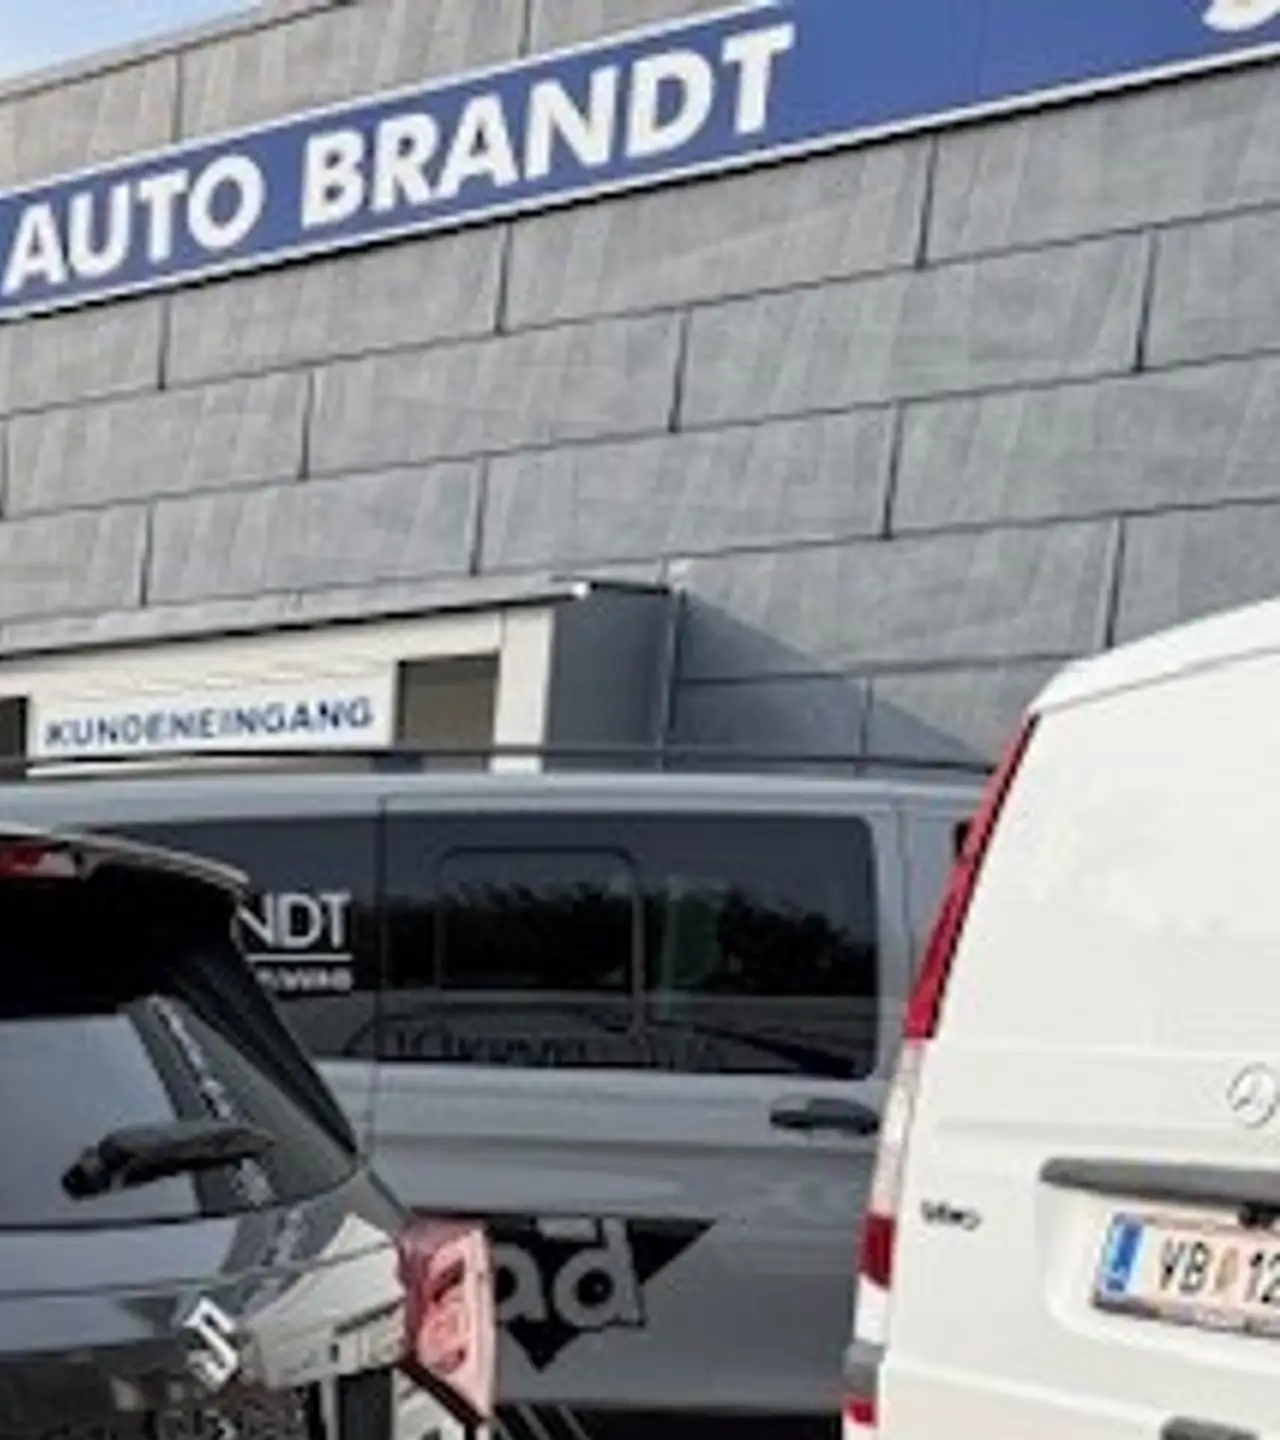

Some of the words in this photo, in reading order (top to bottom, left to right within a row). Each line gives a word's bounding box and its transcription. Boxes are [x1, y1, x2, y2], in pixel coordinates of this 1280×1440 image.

[0, 154, 266, 296] AUTO
[301, 22, 796, 229] BRANDT
[44, 695, 374, 748] KUNDENEINGANG
[237, 891, 352, 948] NDT
